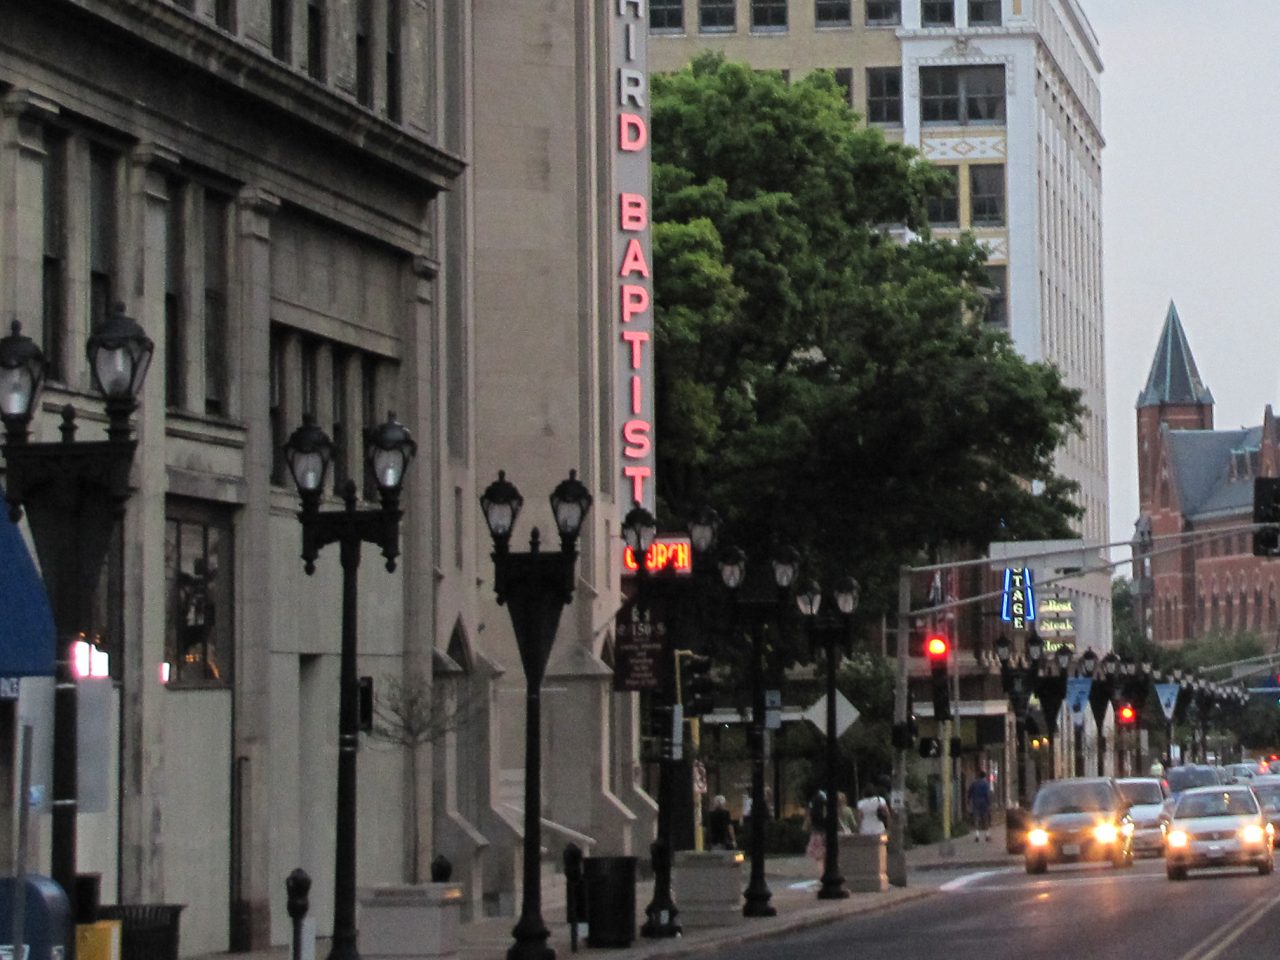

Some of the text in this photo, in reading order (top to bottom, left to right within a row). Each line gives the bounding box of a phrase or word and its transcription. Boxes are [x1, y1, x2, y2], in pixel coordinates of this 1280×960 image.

[620, 193, 651, 504] BAPTIST
[623, 543, 690, 570] CURCH
[1040, 618, 1074, 631] Steak
